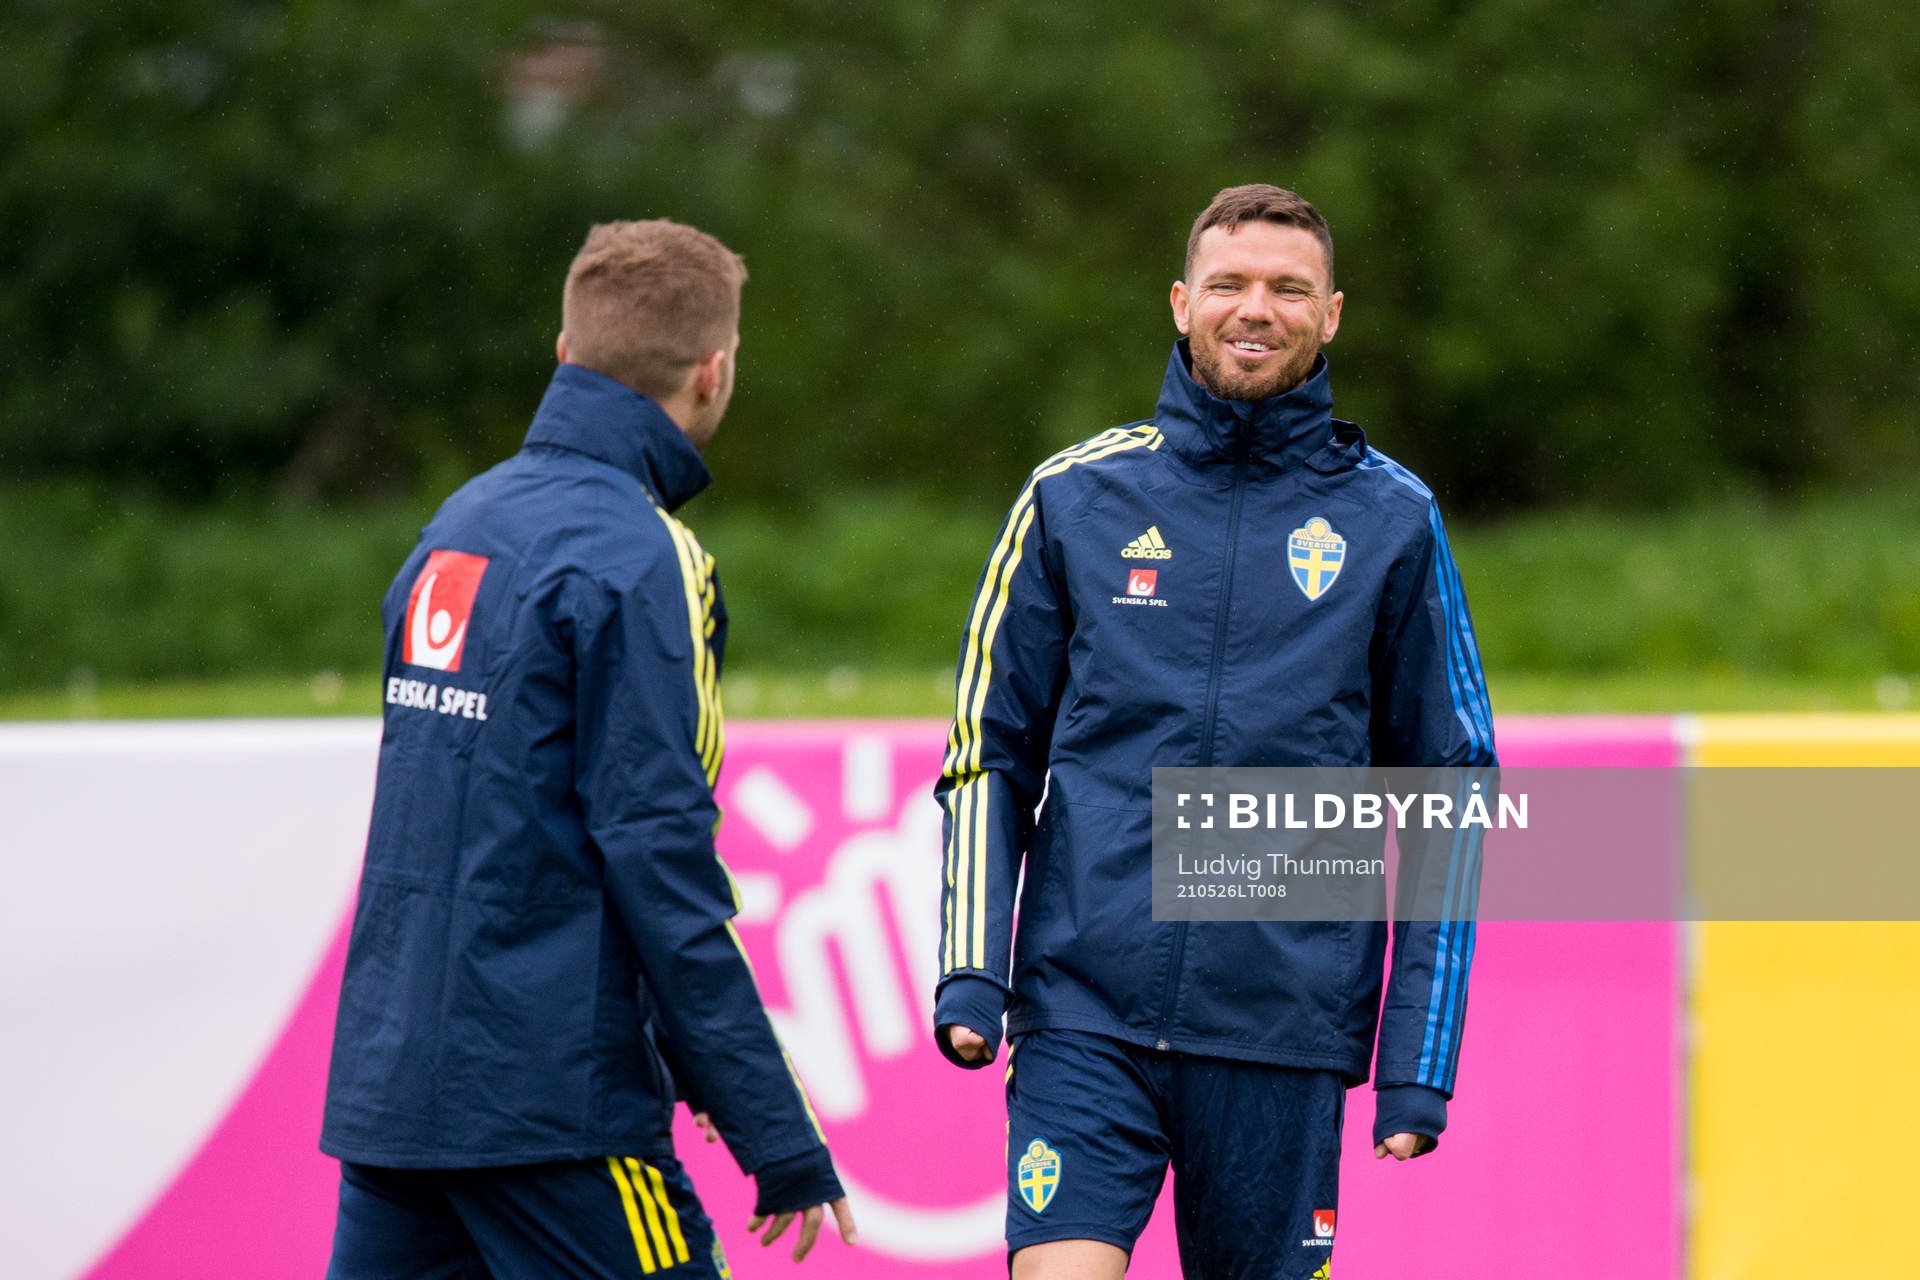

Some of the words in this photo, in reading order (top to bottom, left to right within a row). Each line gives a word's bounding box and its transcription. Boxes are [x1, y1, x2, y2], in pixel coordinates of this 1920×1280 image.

[1121, 547, 1172, 559] adidas
[1112, 596, 1148, 605] SVENSKA
[1148, 598, 1169, 607] SPEL
[438, 686, 488, 721] SPEL
